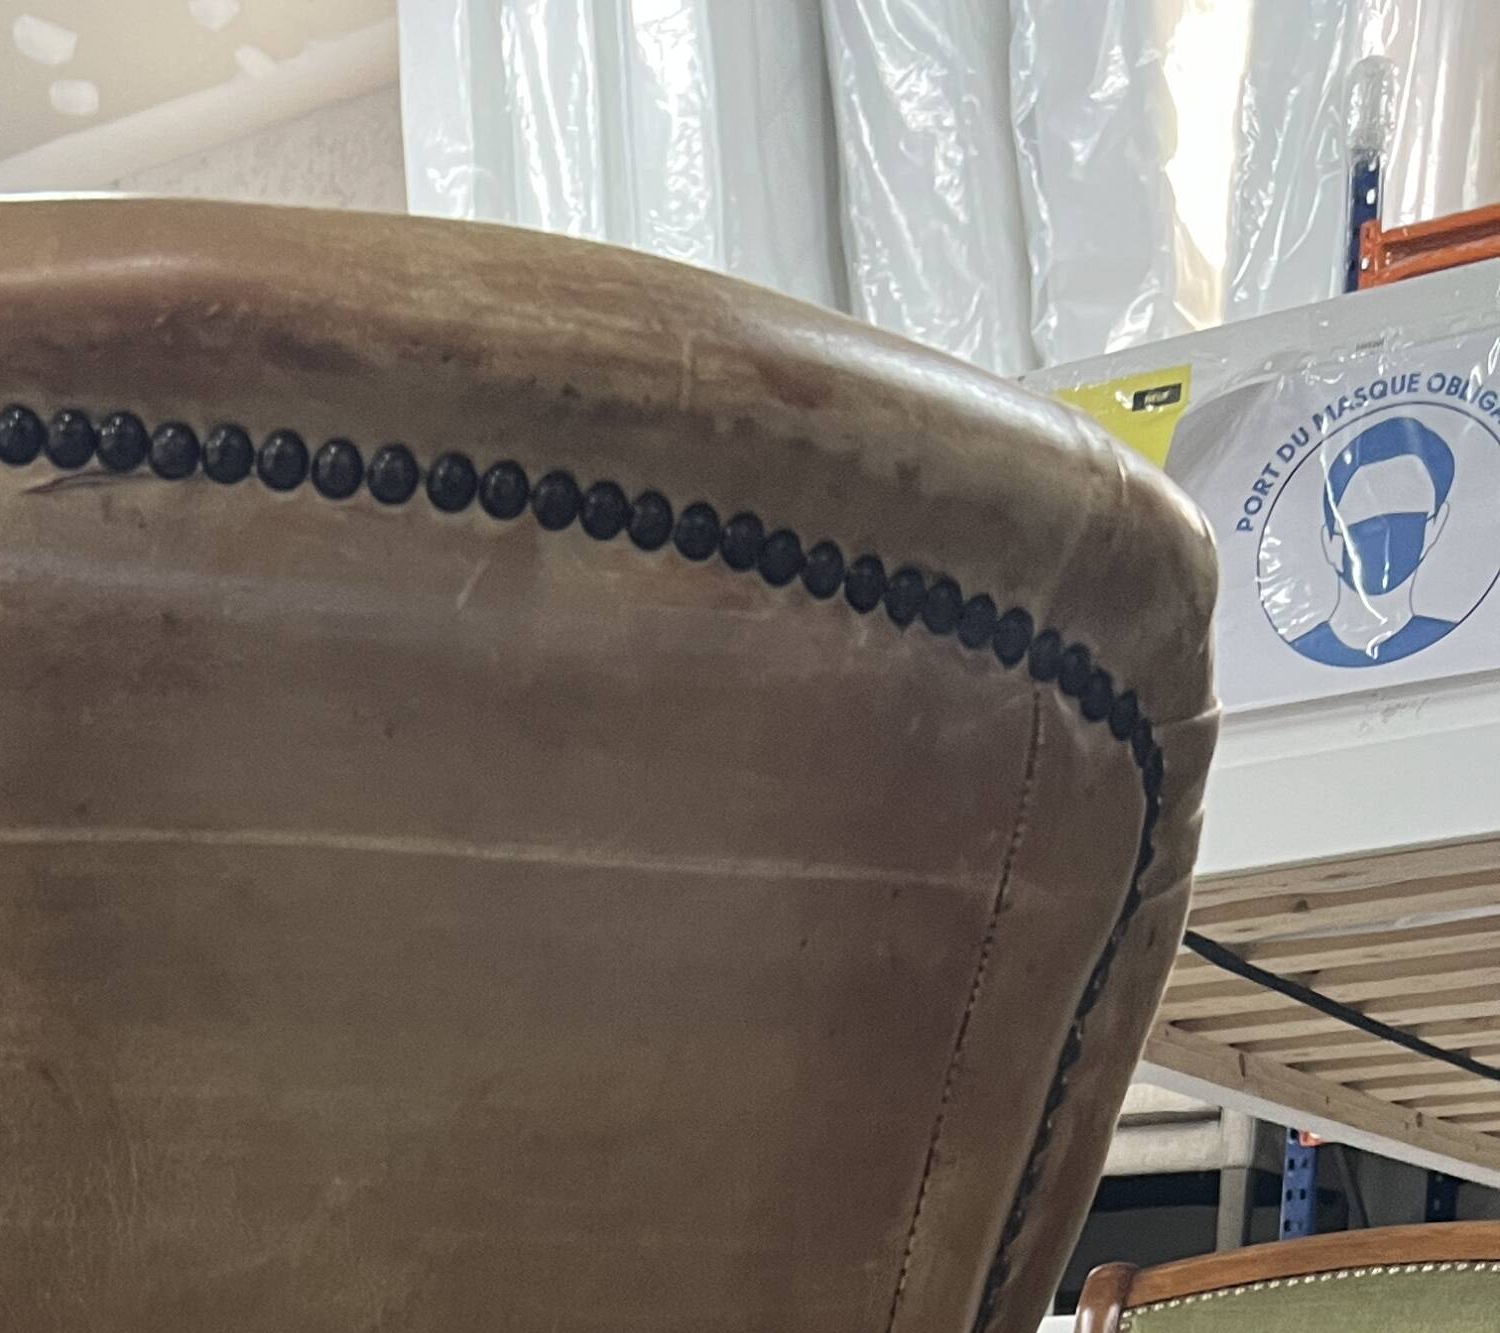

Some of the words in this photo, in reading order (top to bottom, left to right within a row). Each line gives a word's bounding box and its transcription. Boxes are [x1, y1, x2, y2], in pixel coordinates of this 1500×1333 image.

[1236, 462, 1280, 532] PORT
[1276, 427, 1310, 463] DU
[1312, 372, 1421, 433] MASQUE
